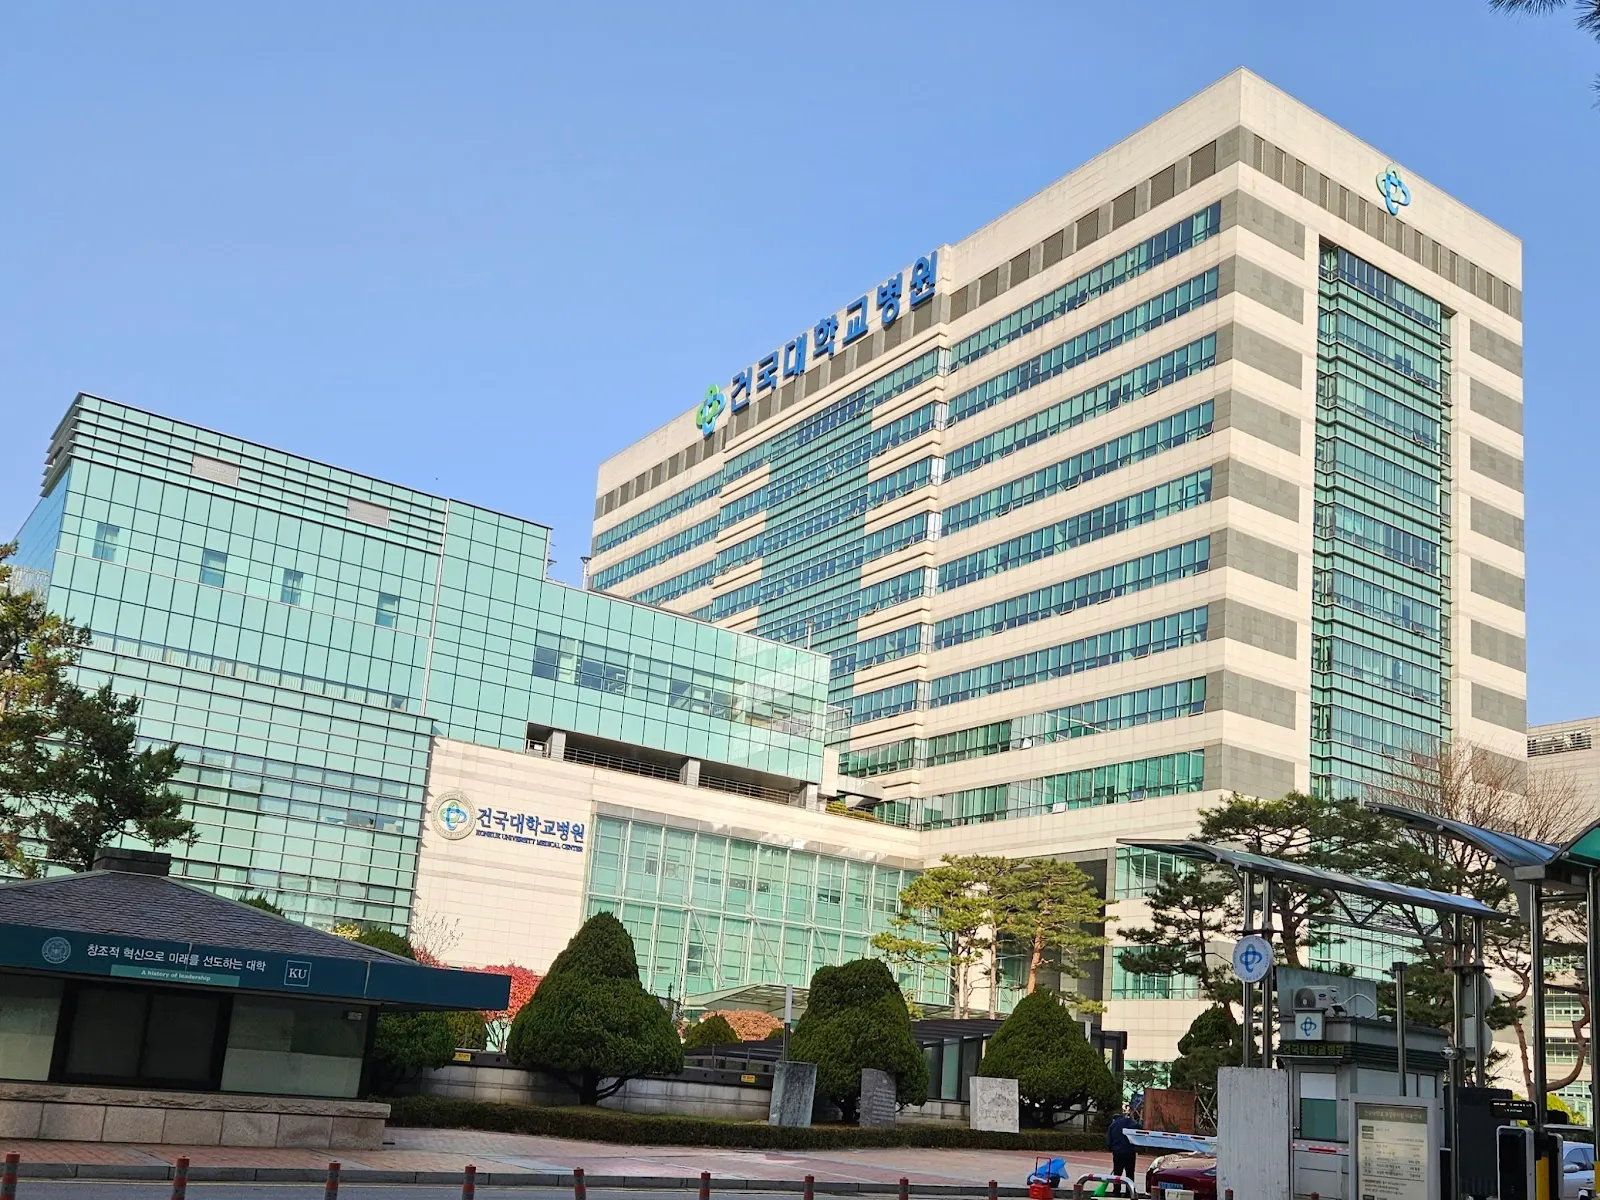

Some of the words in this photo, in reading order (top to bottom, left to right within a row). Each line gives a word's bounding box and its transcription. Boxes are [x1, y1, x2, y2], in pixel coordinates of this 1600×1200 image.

[730, 250, 937, 415] 건국대학교병원
[476, 807, 585, 844] 건국대학교병원
[501, 833, 535, 845] UNIVERSITY
[536, 839, 560, 849] MEDICAL
[561, 843, 583, 853] CENTER
[87, 943, 120, 958] 창조적
[123, 947, 165, 962] 혁신으로
[168, 952, 200, 966] 미래를
[202, 955, 243, 970] 선도하는
[246, 960, 267, 973] 대학
[147, 970, 169, 978] history
[178, 973, 211, 982] leadership
[288, 967, 307, 980] KU
